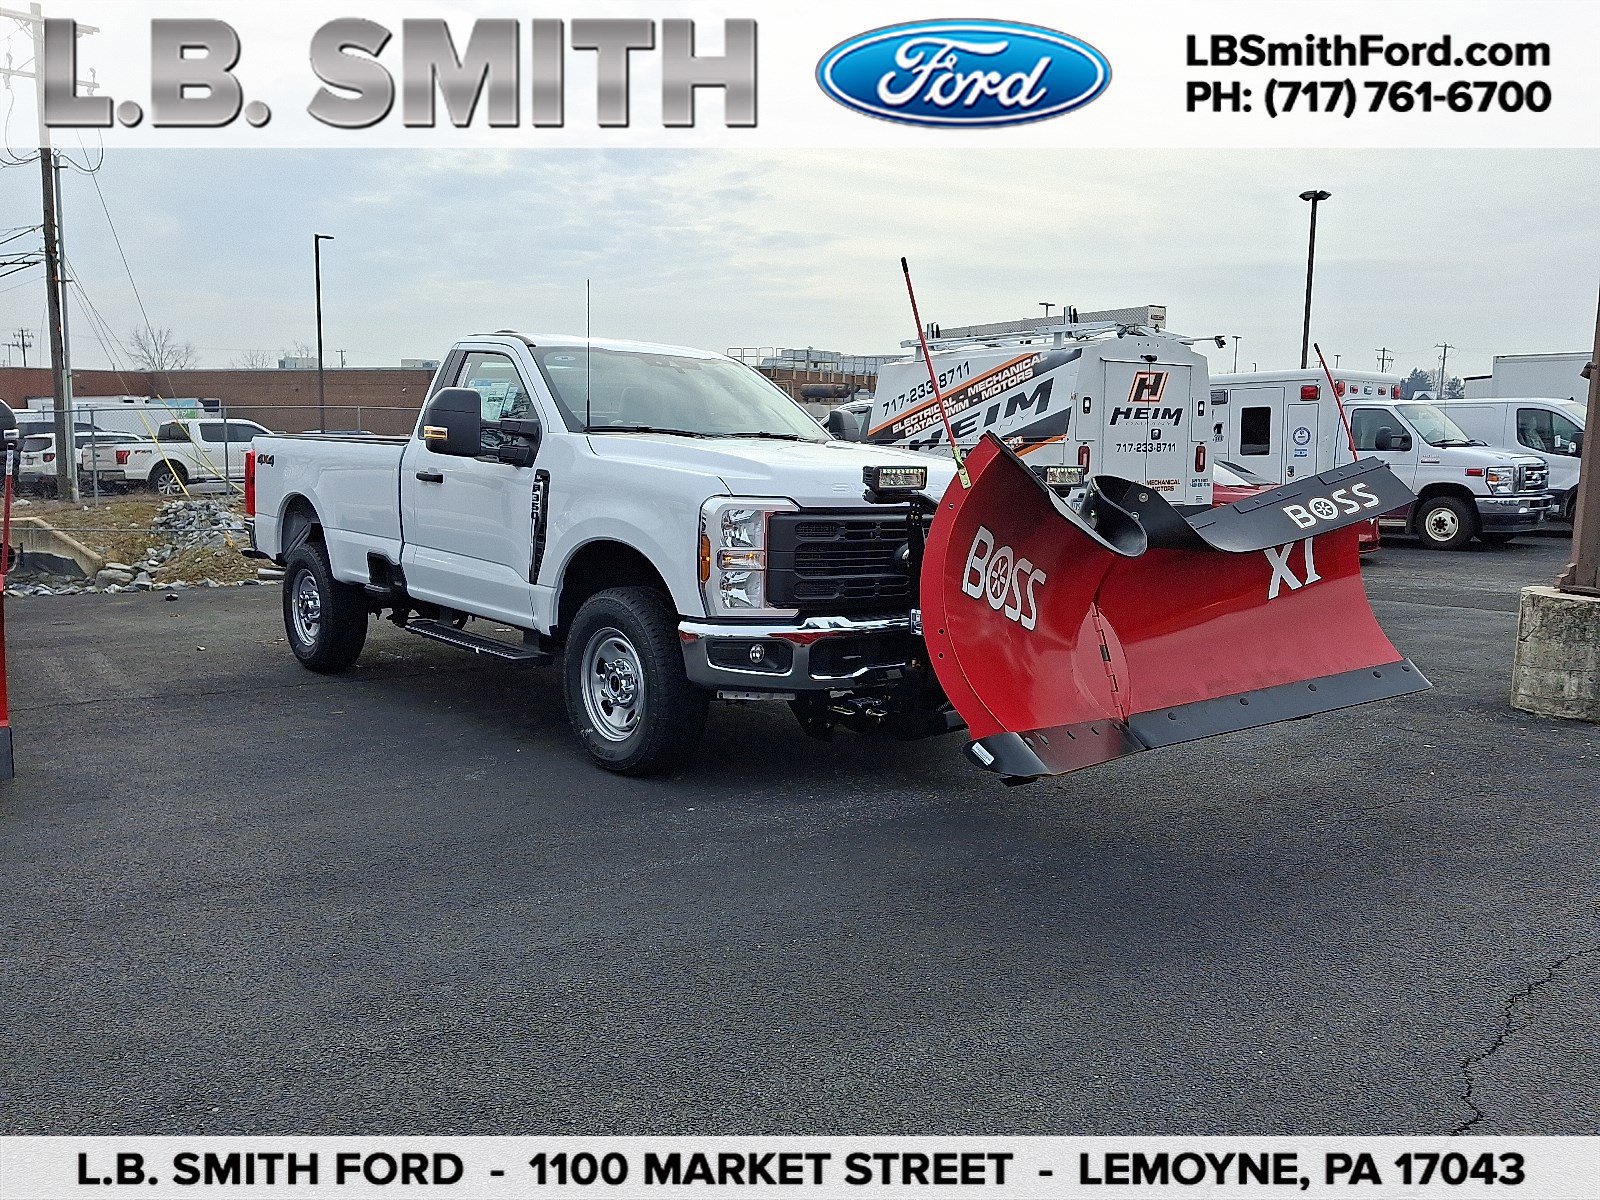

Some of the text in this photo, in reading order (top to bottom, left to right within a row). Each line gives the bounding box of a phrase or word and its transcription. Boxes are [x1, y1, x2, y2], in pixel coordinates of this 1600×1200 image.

[967, 353, 1048, 396] MECHANICAL
[905, 399, 969, 438] DATACMM
[981, 369, 1034, 400] MOTORS
[1109, 407, 1184, 426] HEIM
[1116, 443, 1176, 452] 717-233-8711
[1282, 482, 1381, 530] BOSS
[961, 525, 1047, 631] BOSS
